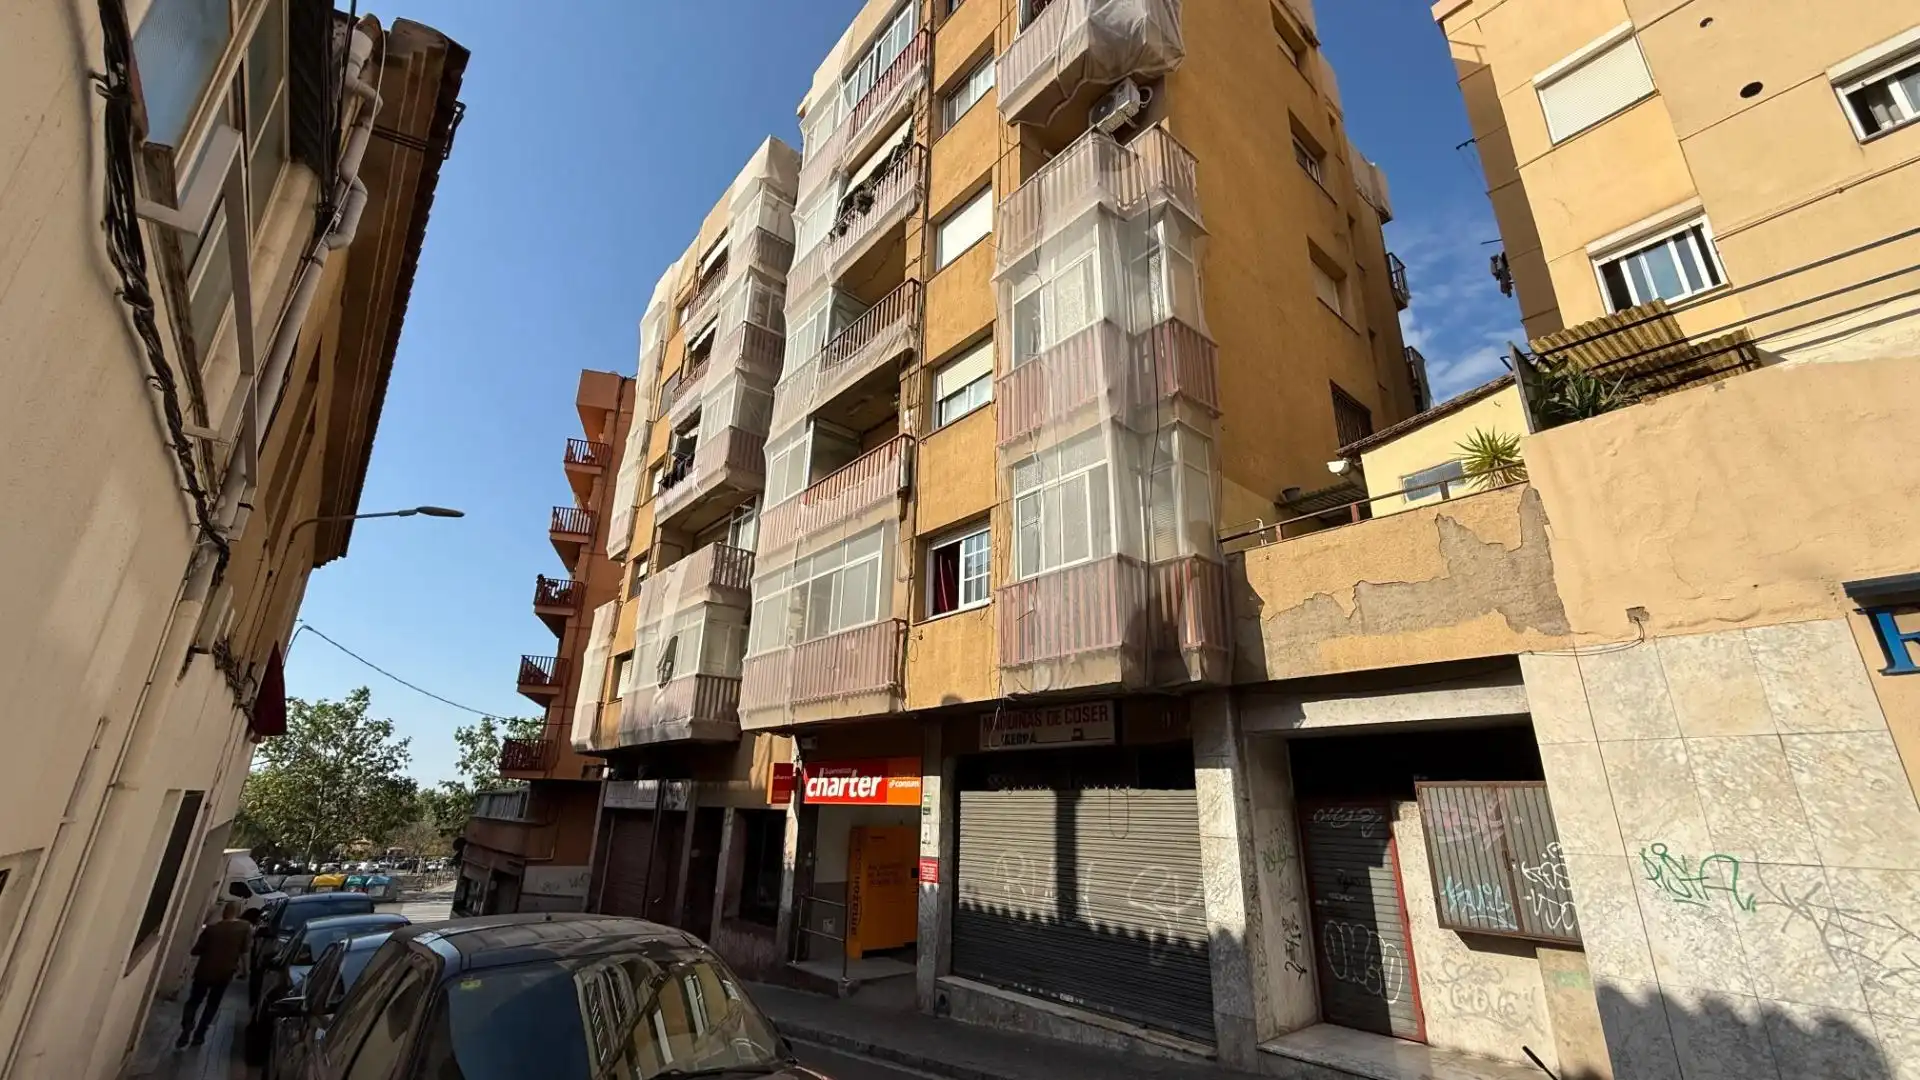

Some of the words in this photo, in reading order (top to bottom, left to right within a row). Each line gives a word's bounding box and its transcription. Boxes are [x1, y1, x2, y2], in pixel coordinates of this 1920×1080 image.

[1046, 710, 1062, 727] DE
[1064, 705, 1109, 724] COSER
[806, 768, 882, 798] charter
